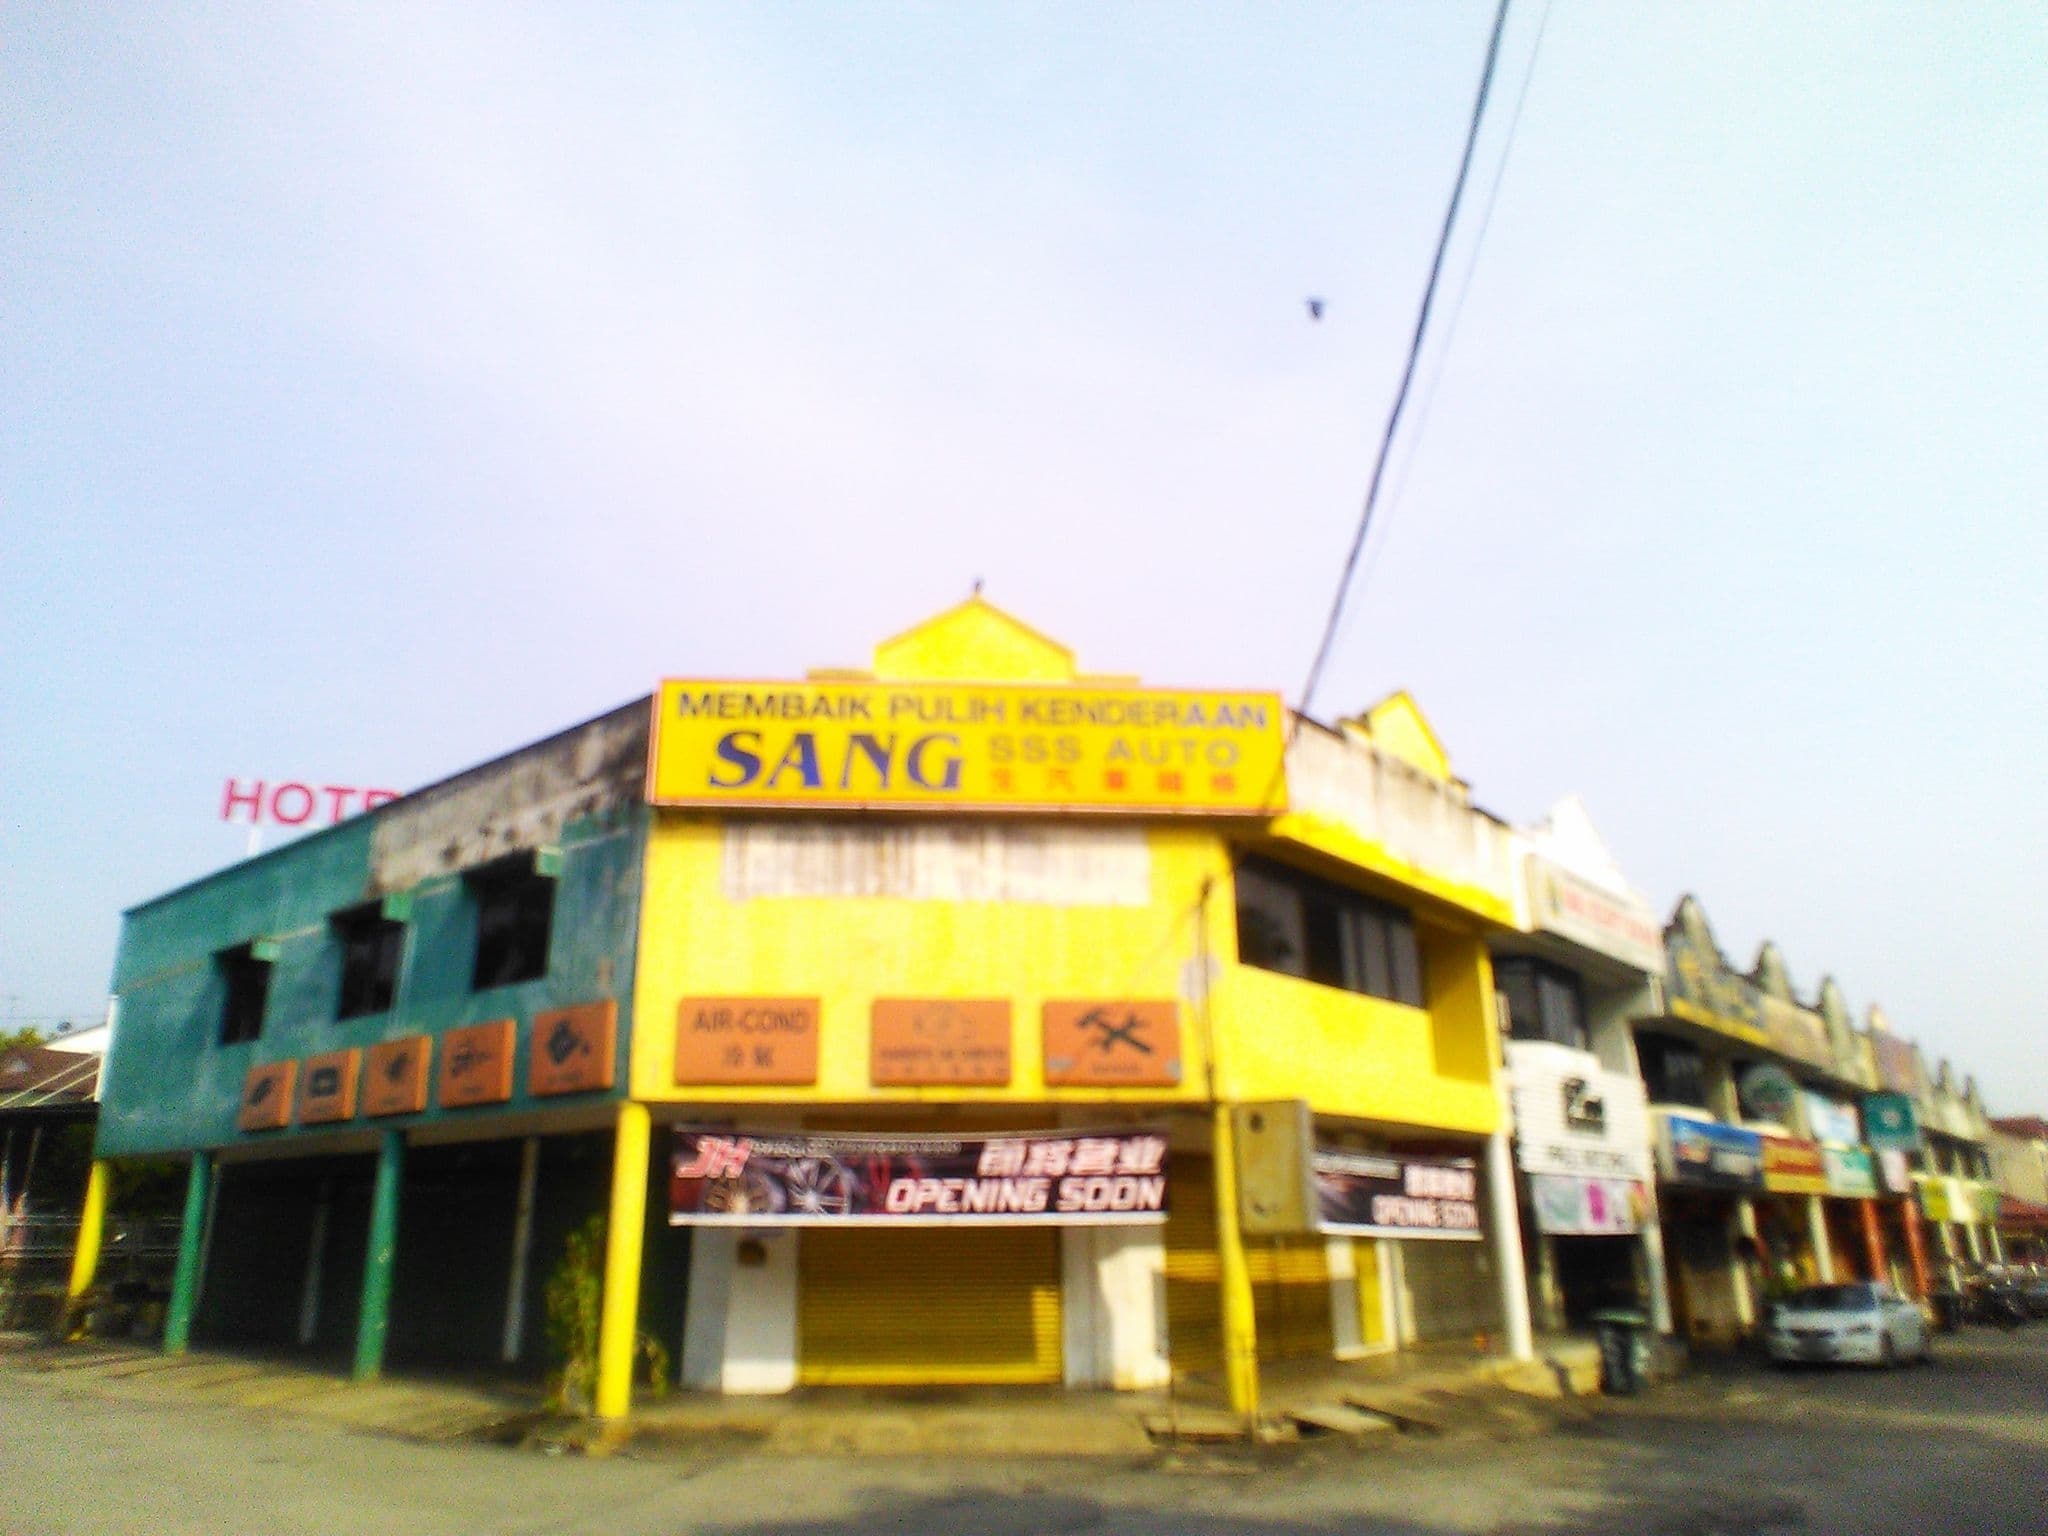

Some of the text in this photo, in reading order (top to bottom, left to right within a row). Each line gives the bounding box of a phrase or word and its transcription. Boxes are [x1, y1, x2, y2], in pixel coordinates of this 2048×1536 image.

[679, 692, 1268, 733] MEMBAIK PULIH KENDERAAN
[708, 729, 962, 790] SANG
[989, 734, 1240, 768] SSS AUTO
[885, 1174, 1167, 1213] OPENING SOON
